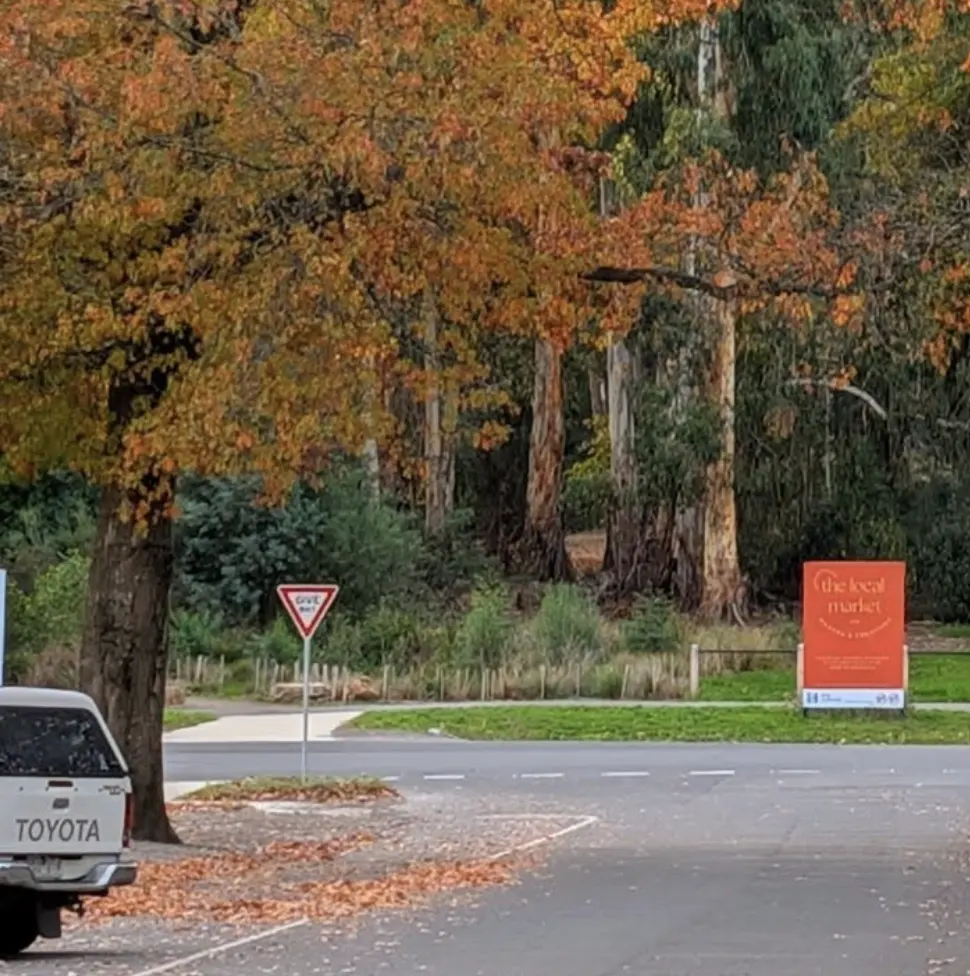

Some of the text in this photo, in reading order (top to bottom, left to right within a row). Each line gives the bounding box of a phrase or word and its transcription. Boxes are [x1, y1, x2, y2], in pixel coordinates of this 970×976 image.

[821, 576, 886, 593] the local
[295, 596, 321, 605] GIVE
[828, 596, 882, 614] market
[15, 818, 100, 842] TOYOTA
